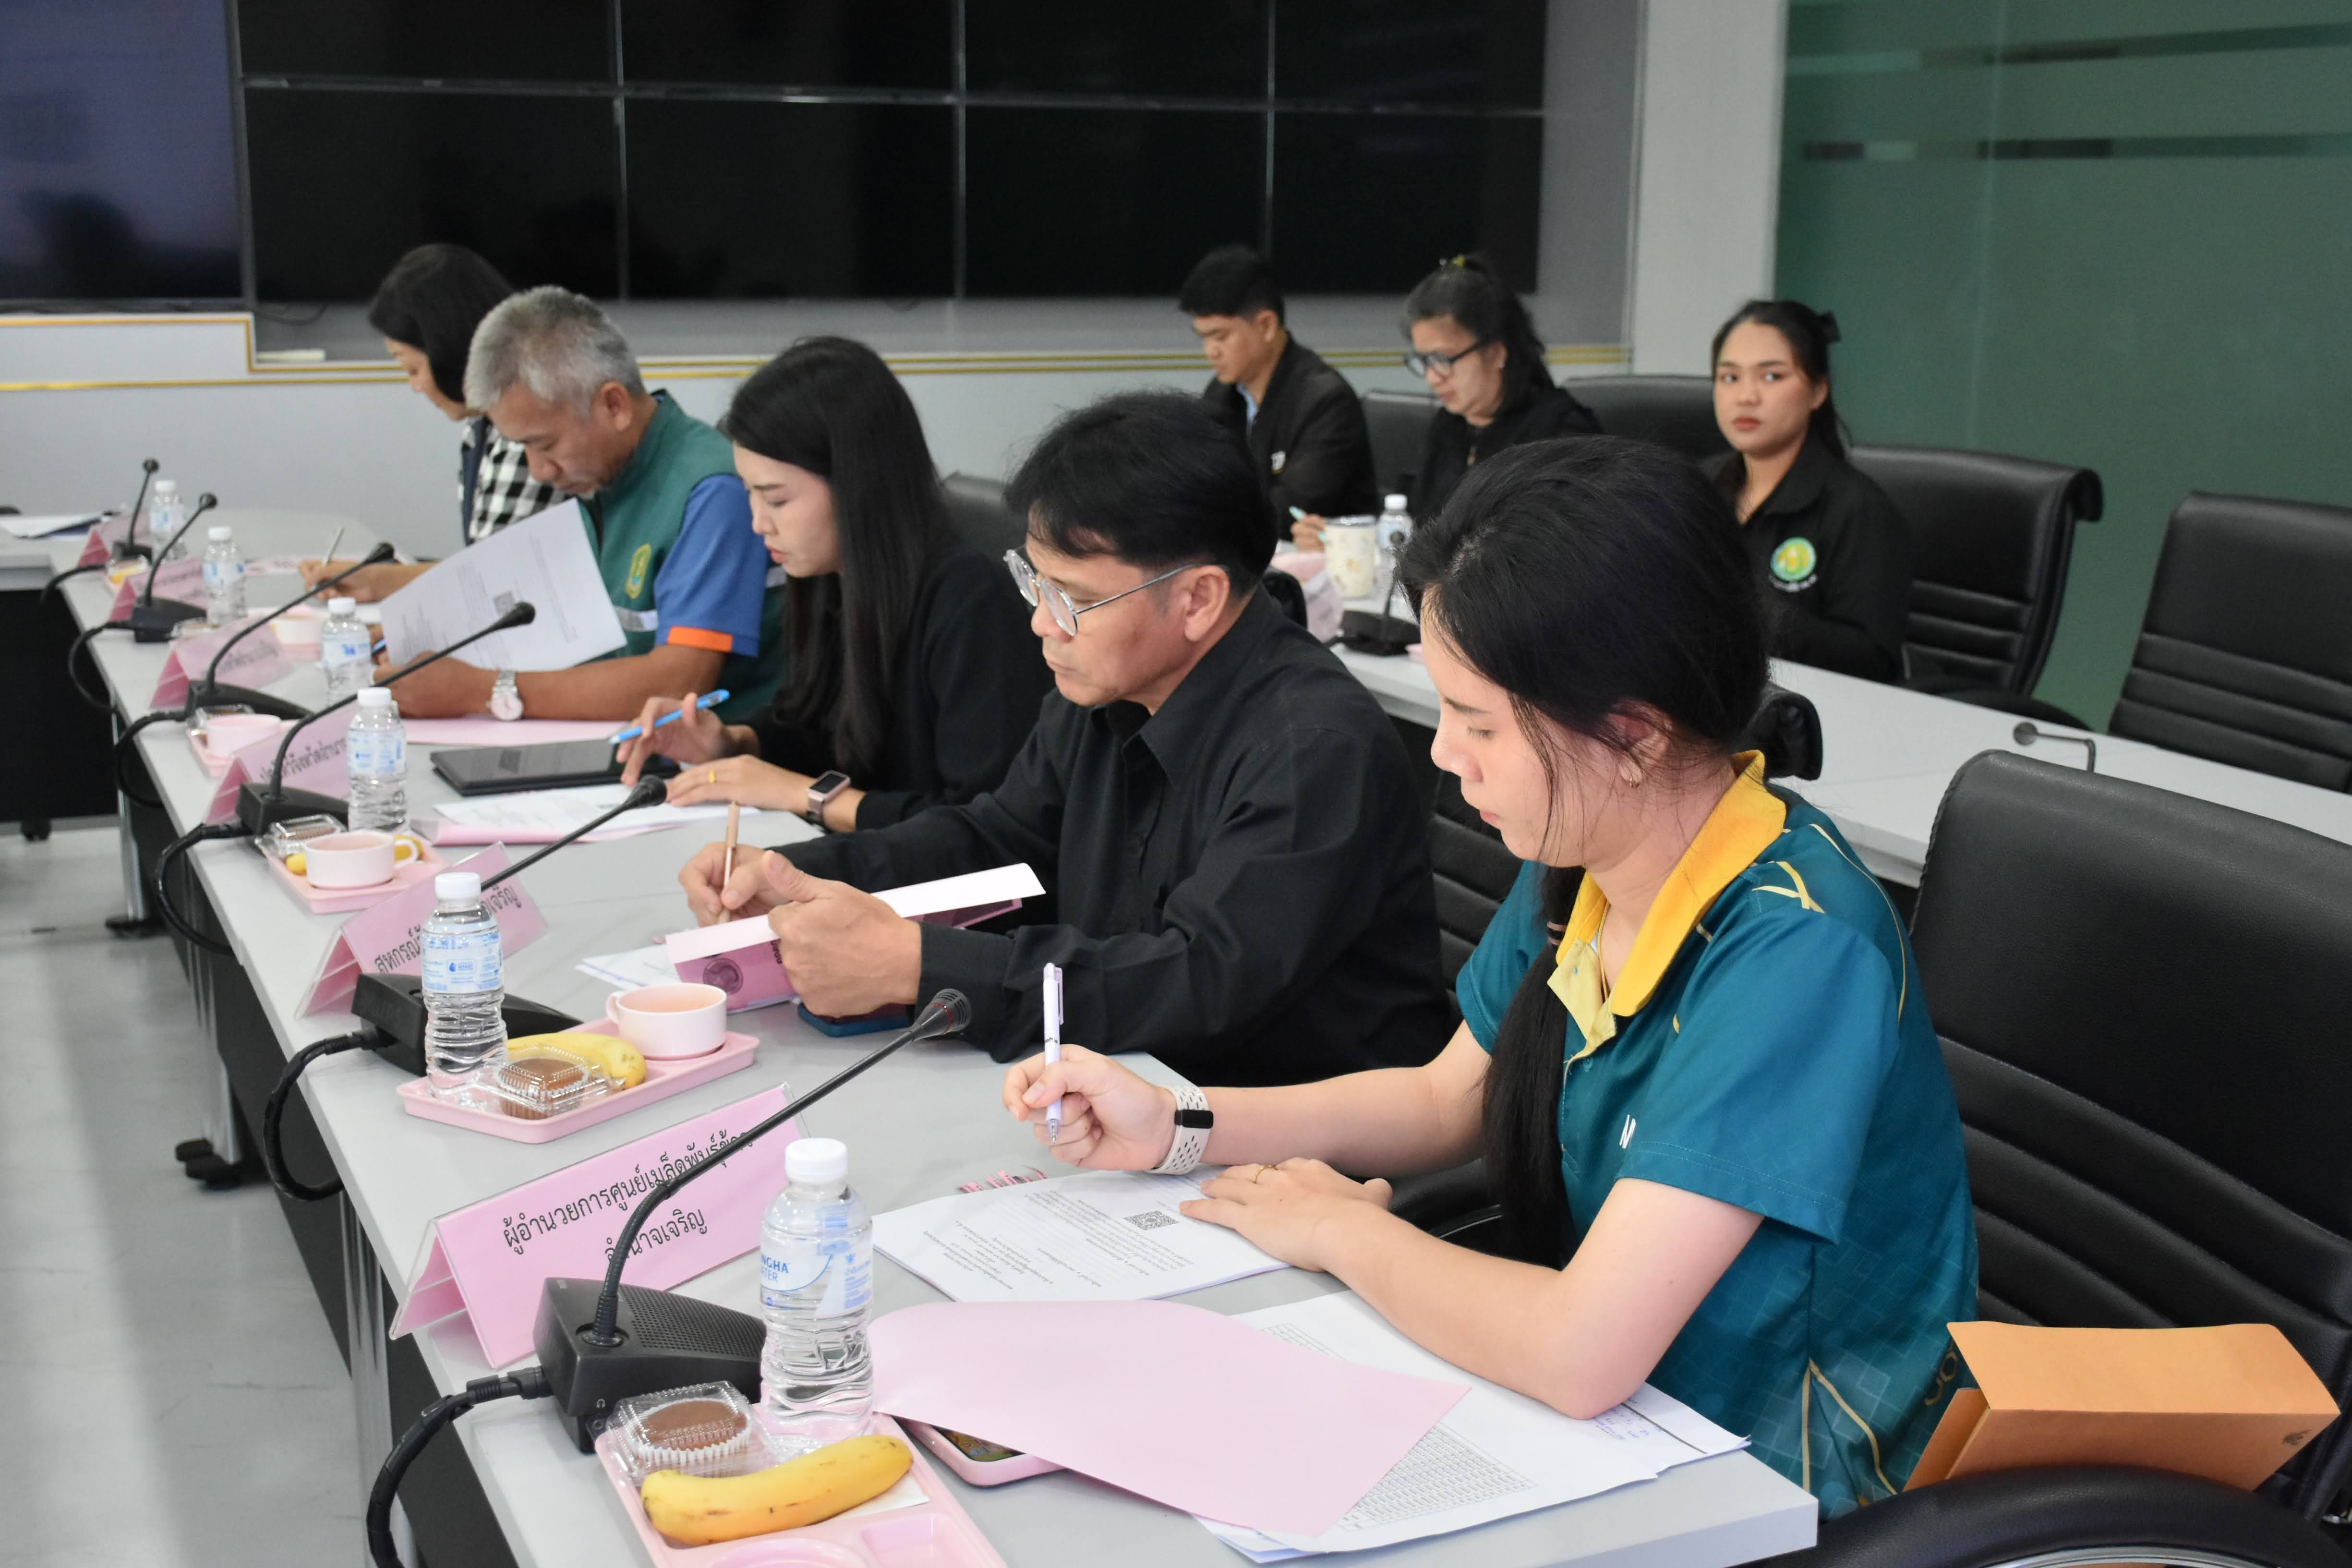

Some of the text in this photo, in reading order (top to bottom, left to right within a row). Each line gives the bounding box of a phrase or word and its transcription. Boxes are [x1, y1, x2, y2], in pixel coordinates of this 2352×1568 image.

[503, 1129, 753, 1255] ผู้อำนวยการศูนย์เมล็ดพันุ์้
[605, 1208, 707, 1262] อนาจเจริญ
[761, 1253, 789, 1274] NGHA
